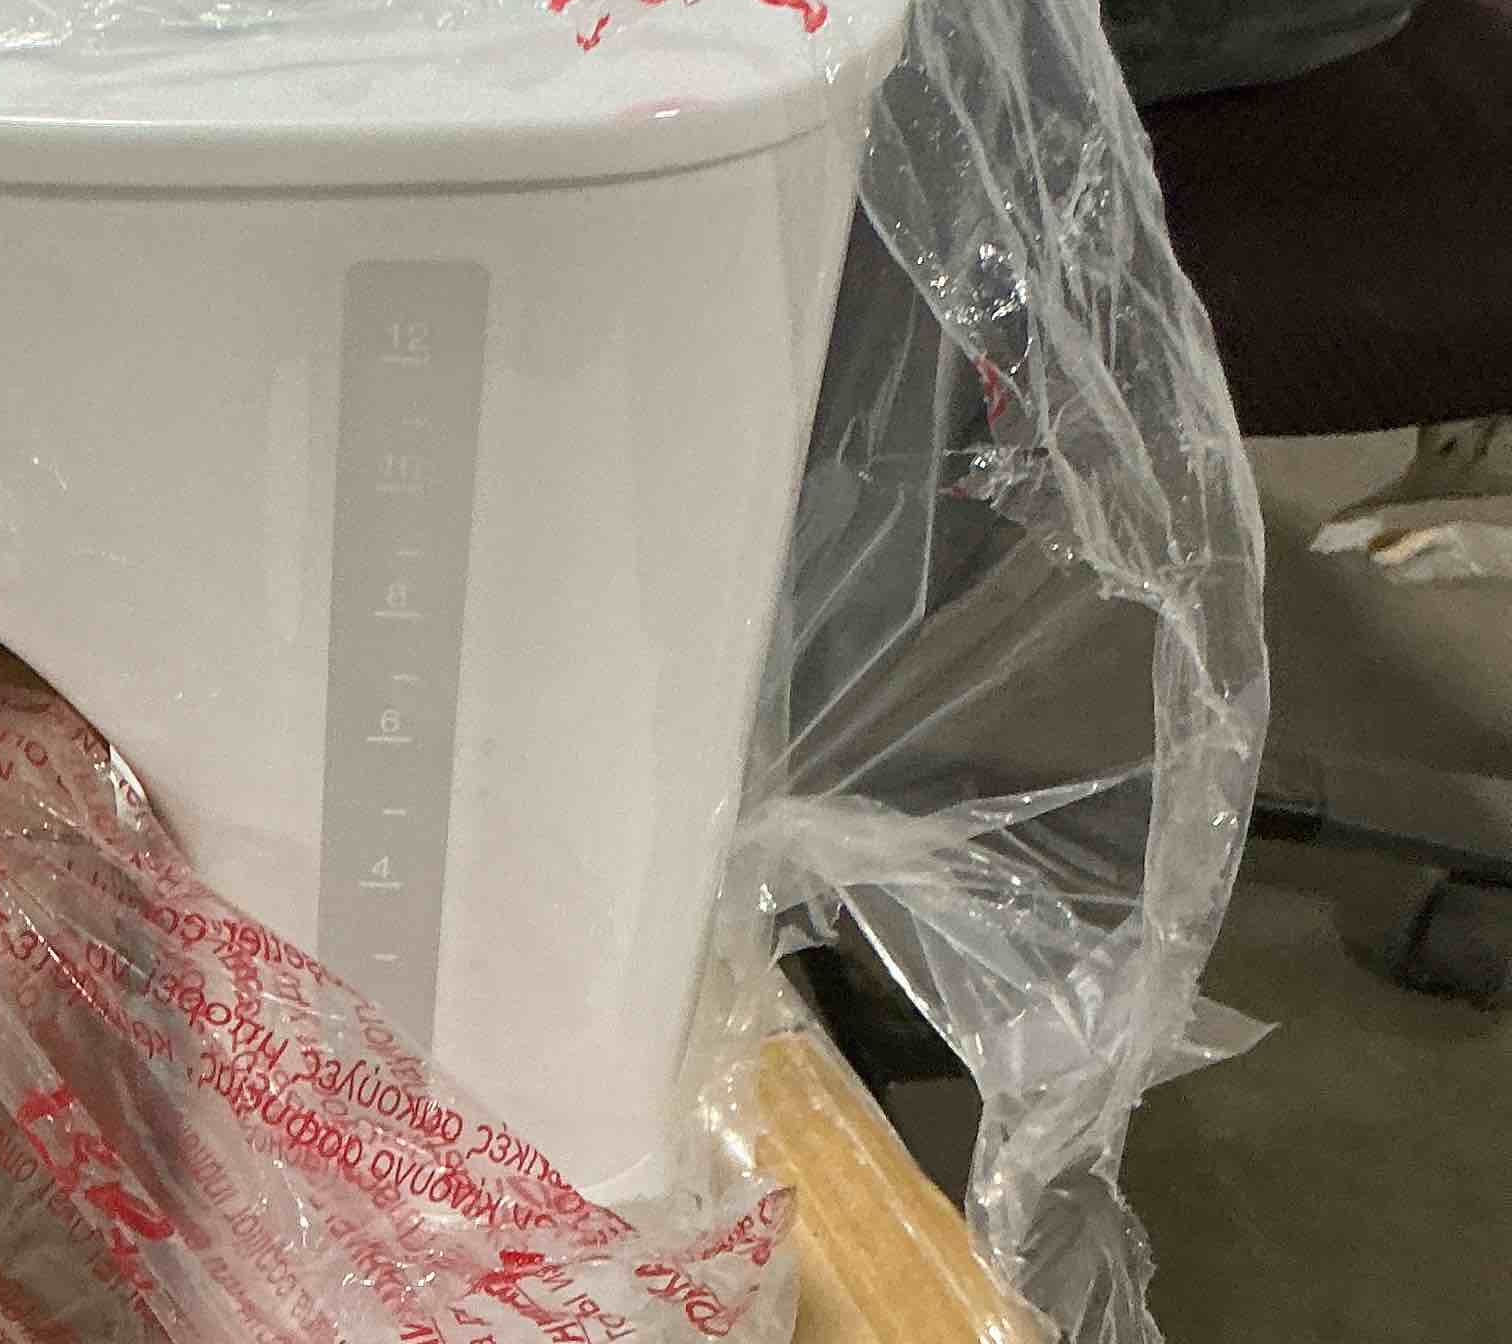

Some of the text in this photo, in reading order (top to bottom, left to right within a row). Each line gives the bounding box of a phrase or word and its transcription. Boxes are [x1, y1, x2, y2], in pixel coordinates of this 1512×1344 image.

[386, 320, 431, 354] 12
[379, 707, 403, 735] 6
[369, 855, 393, 881] 4
